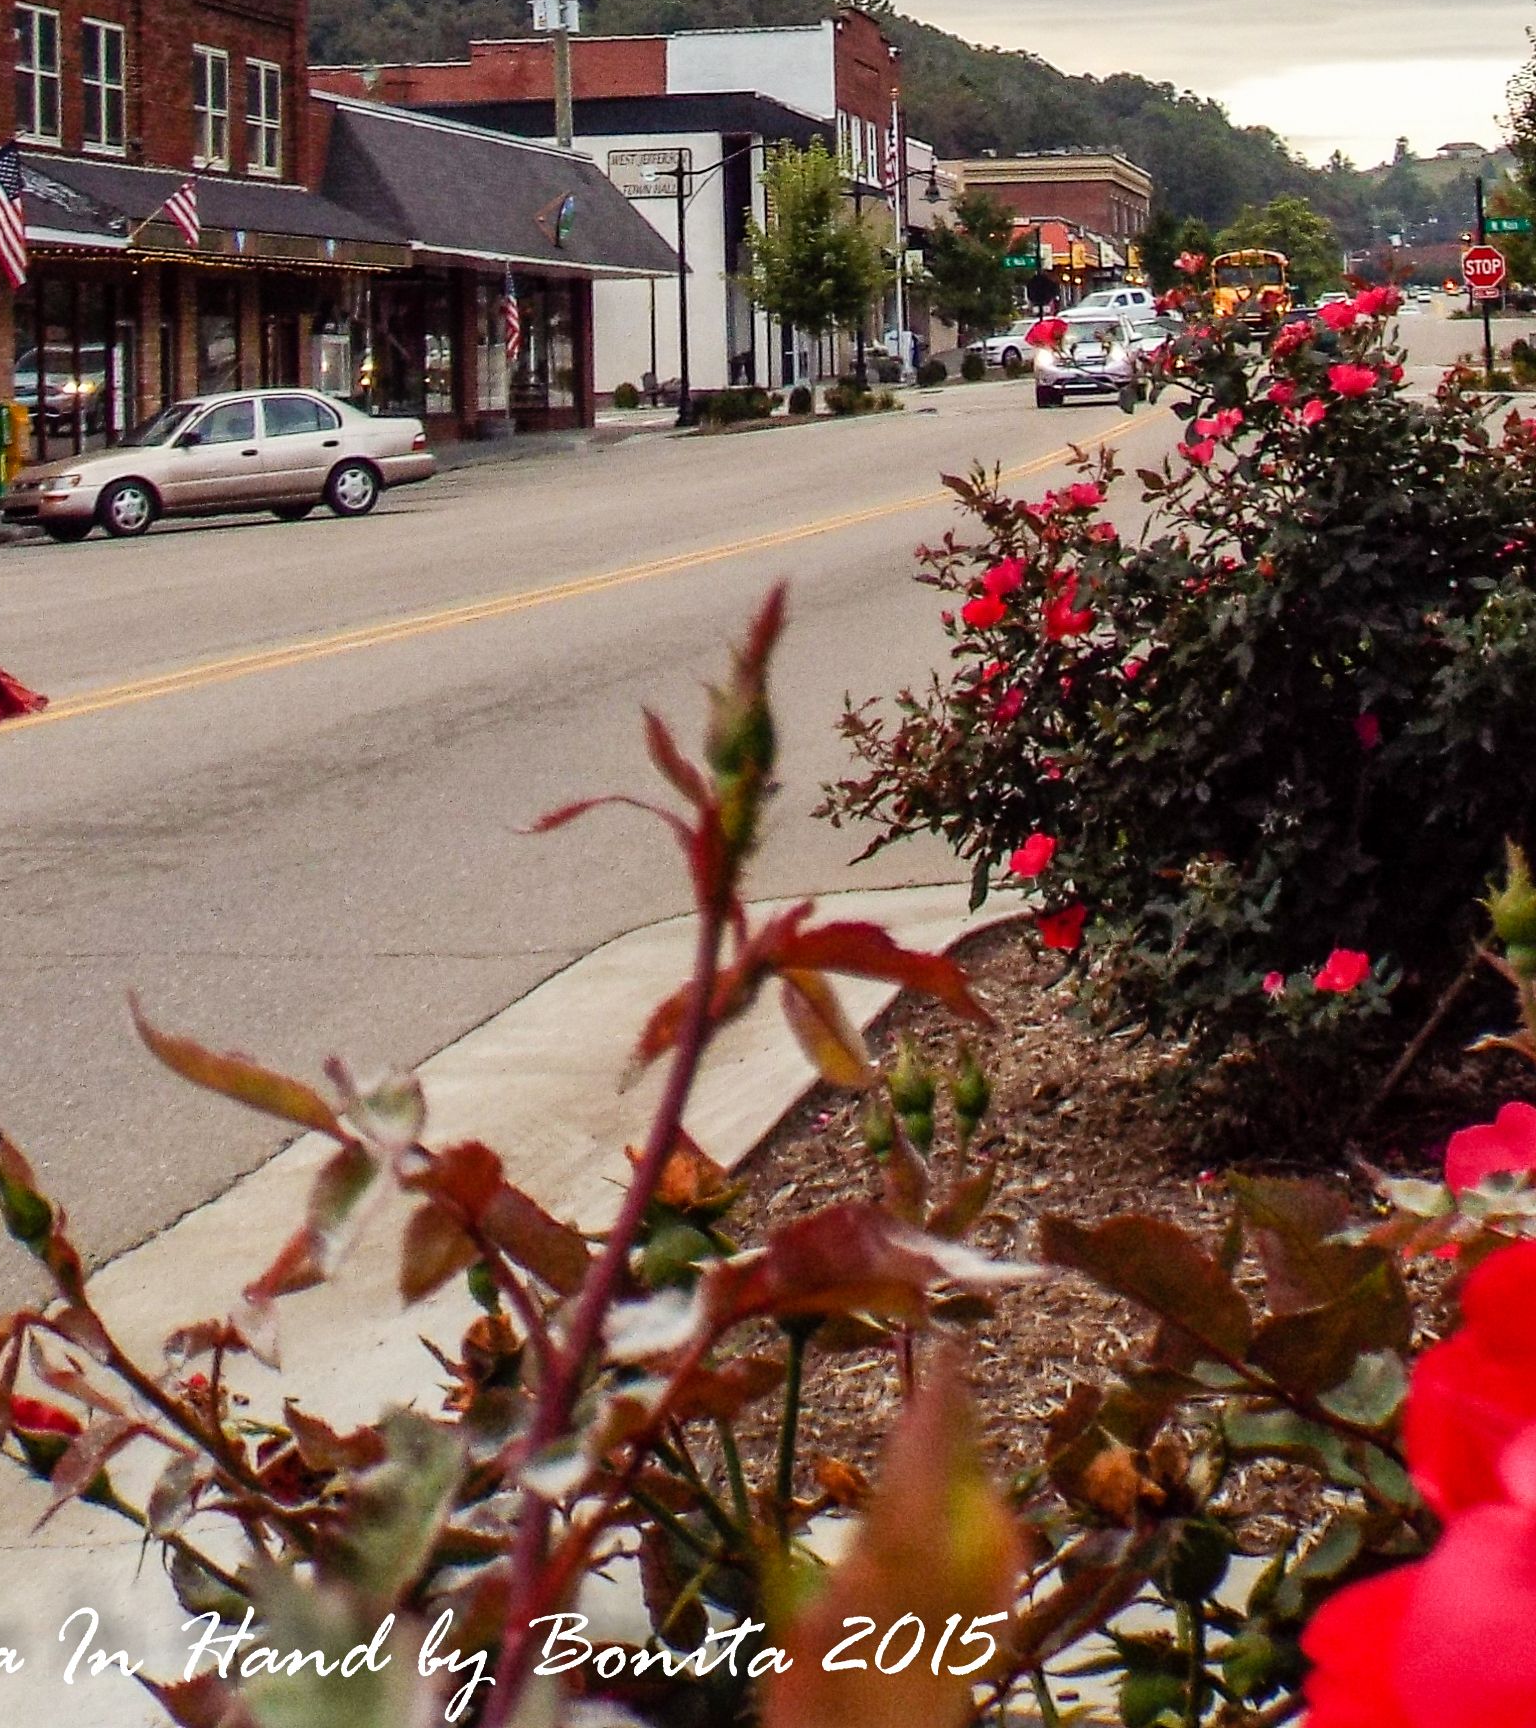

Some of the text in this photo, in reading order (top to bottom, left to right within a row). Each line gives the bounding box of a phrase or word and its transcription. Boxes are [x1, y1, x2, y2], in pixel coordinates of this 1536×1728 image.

[611, 153, 637, 166] WEST
[623, 183, 677, 196] TOWN HALL
[1465, 258, 1501, 275] STOP
